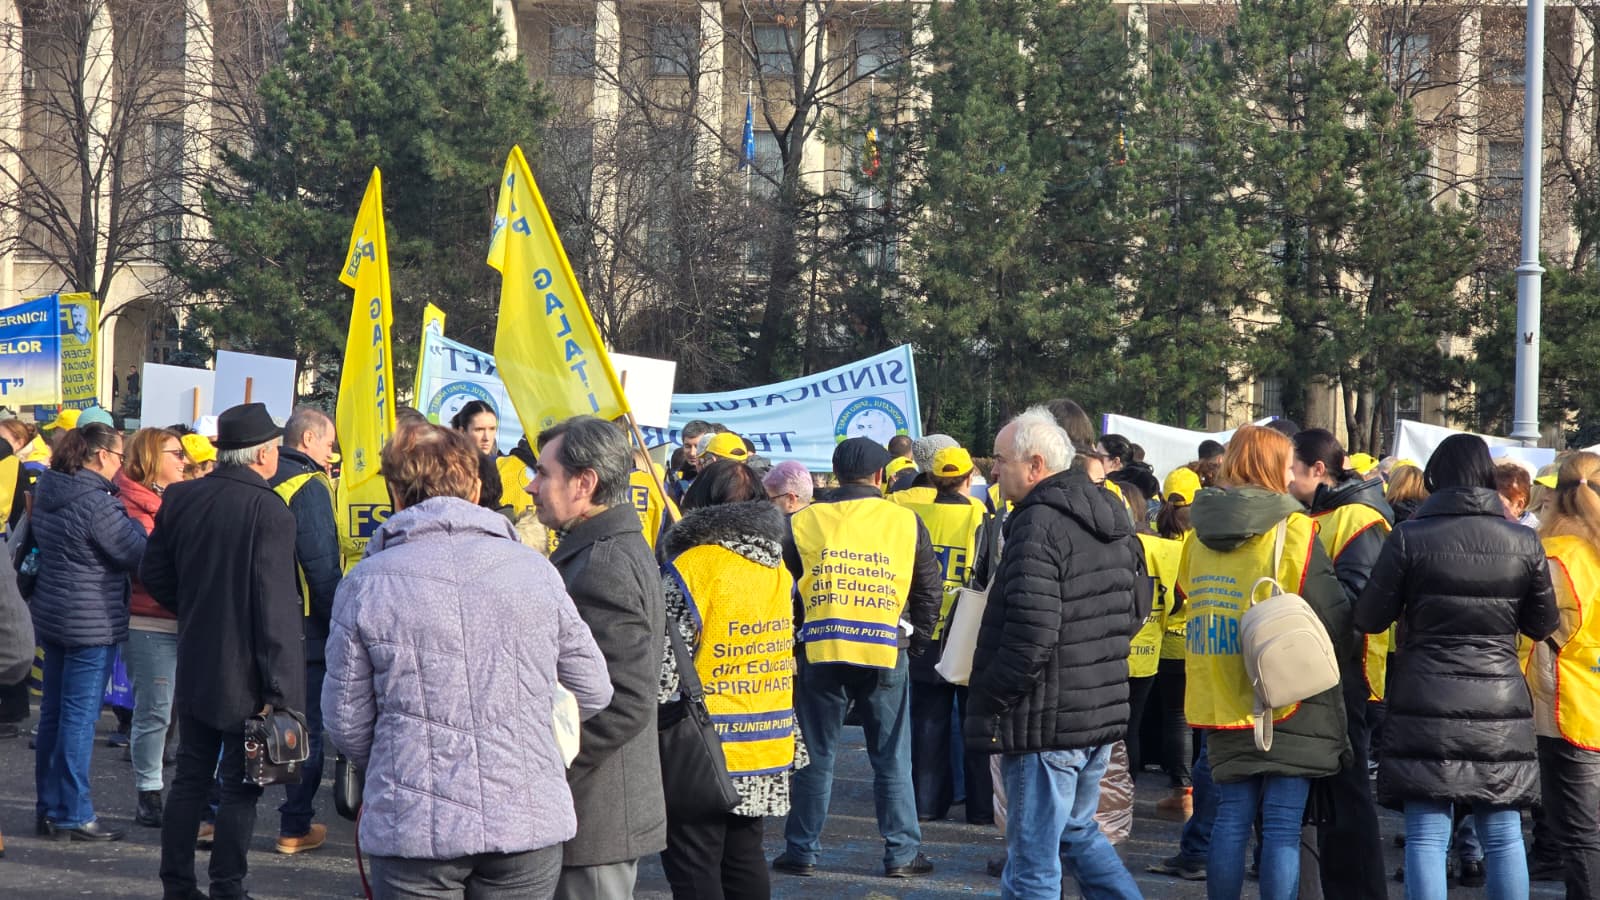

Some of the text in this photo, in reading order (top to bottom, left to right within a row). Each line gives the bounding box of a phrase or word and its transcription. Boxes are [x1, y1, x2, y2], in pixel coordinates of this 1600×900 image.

[811, 563, 897, 582] Sindicatelor
[812, 578, 832, 592] din
[712, 663, 741, 678] din
[731, 720, 772, 733] SUNTEM
